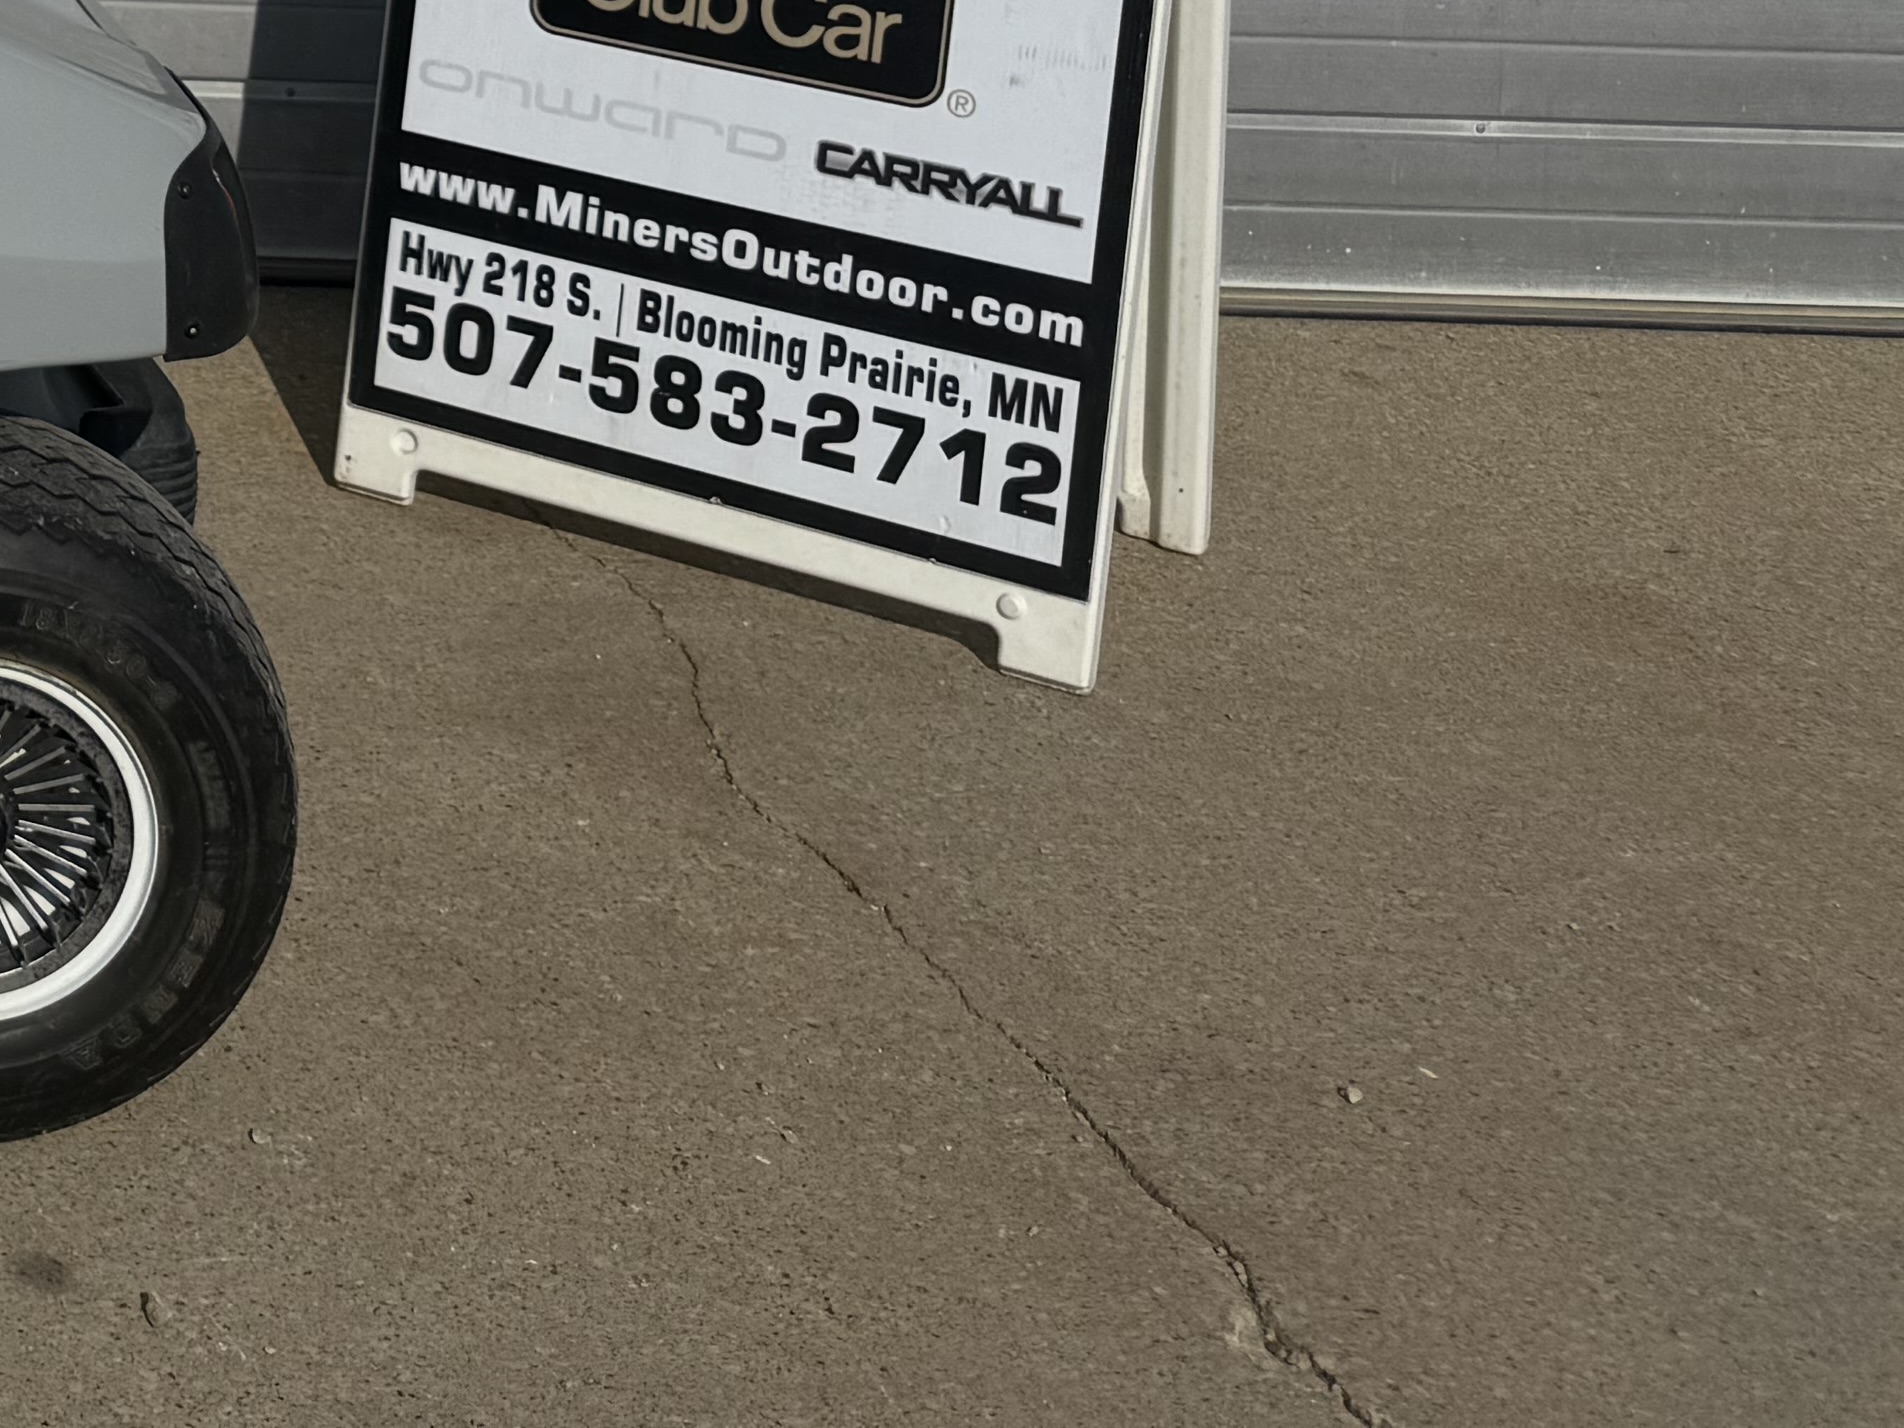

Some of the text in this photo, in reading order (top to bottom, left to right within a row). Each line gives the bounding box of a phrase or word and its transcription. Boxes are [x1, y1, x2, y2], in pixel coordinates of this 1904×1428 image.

[398, 161, 1083, 347] www.MinersOutdoor.com
[813, 138, 1084, 229] CARRYALL
[386, 287, 1064, 527] 507-583-2712
[397, 230, 473, 296] Hwy
[482, 251, 556, 309] 218
[566, 272, 602, 322] S.
[636, 290, 806, 381] Blooming
[819, 333, 973, 419] Prairie,
[988, 373, 1064, 433] MN
